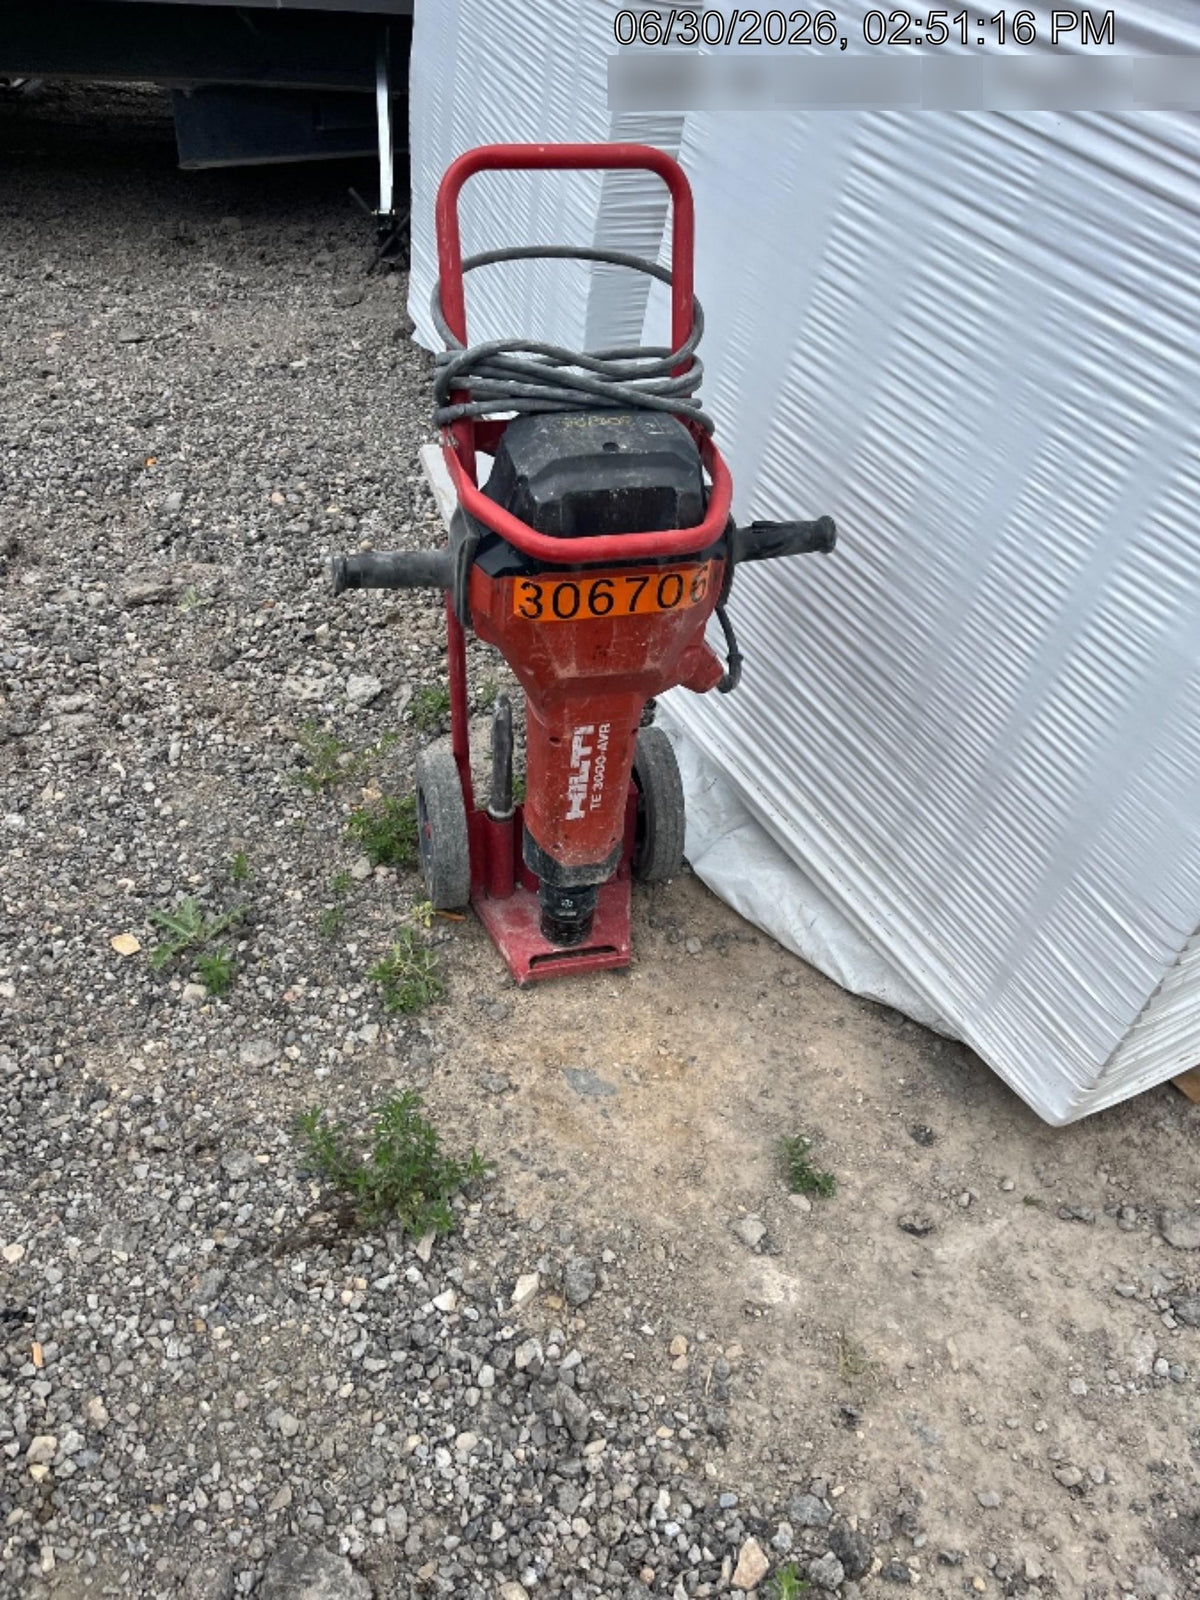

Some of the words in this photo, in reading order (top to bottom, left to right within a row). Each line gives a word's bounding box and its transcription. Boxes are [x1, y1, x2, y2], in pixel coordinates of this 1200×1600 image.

[519, 565, 708, 619] 306706
[565, 725, 594, 820] HILTI
[590, 793, 602, 811] TE
